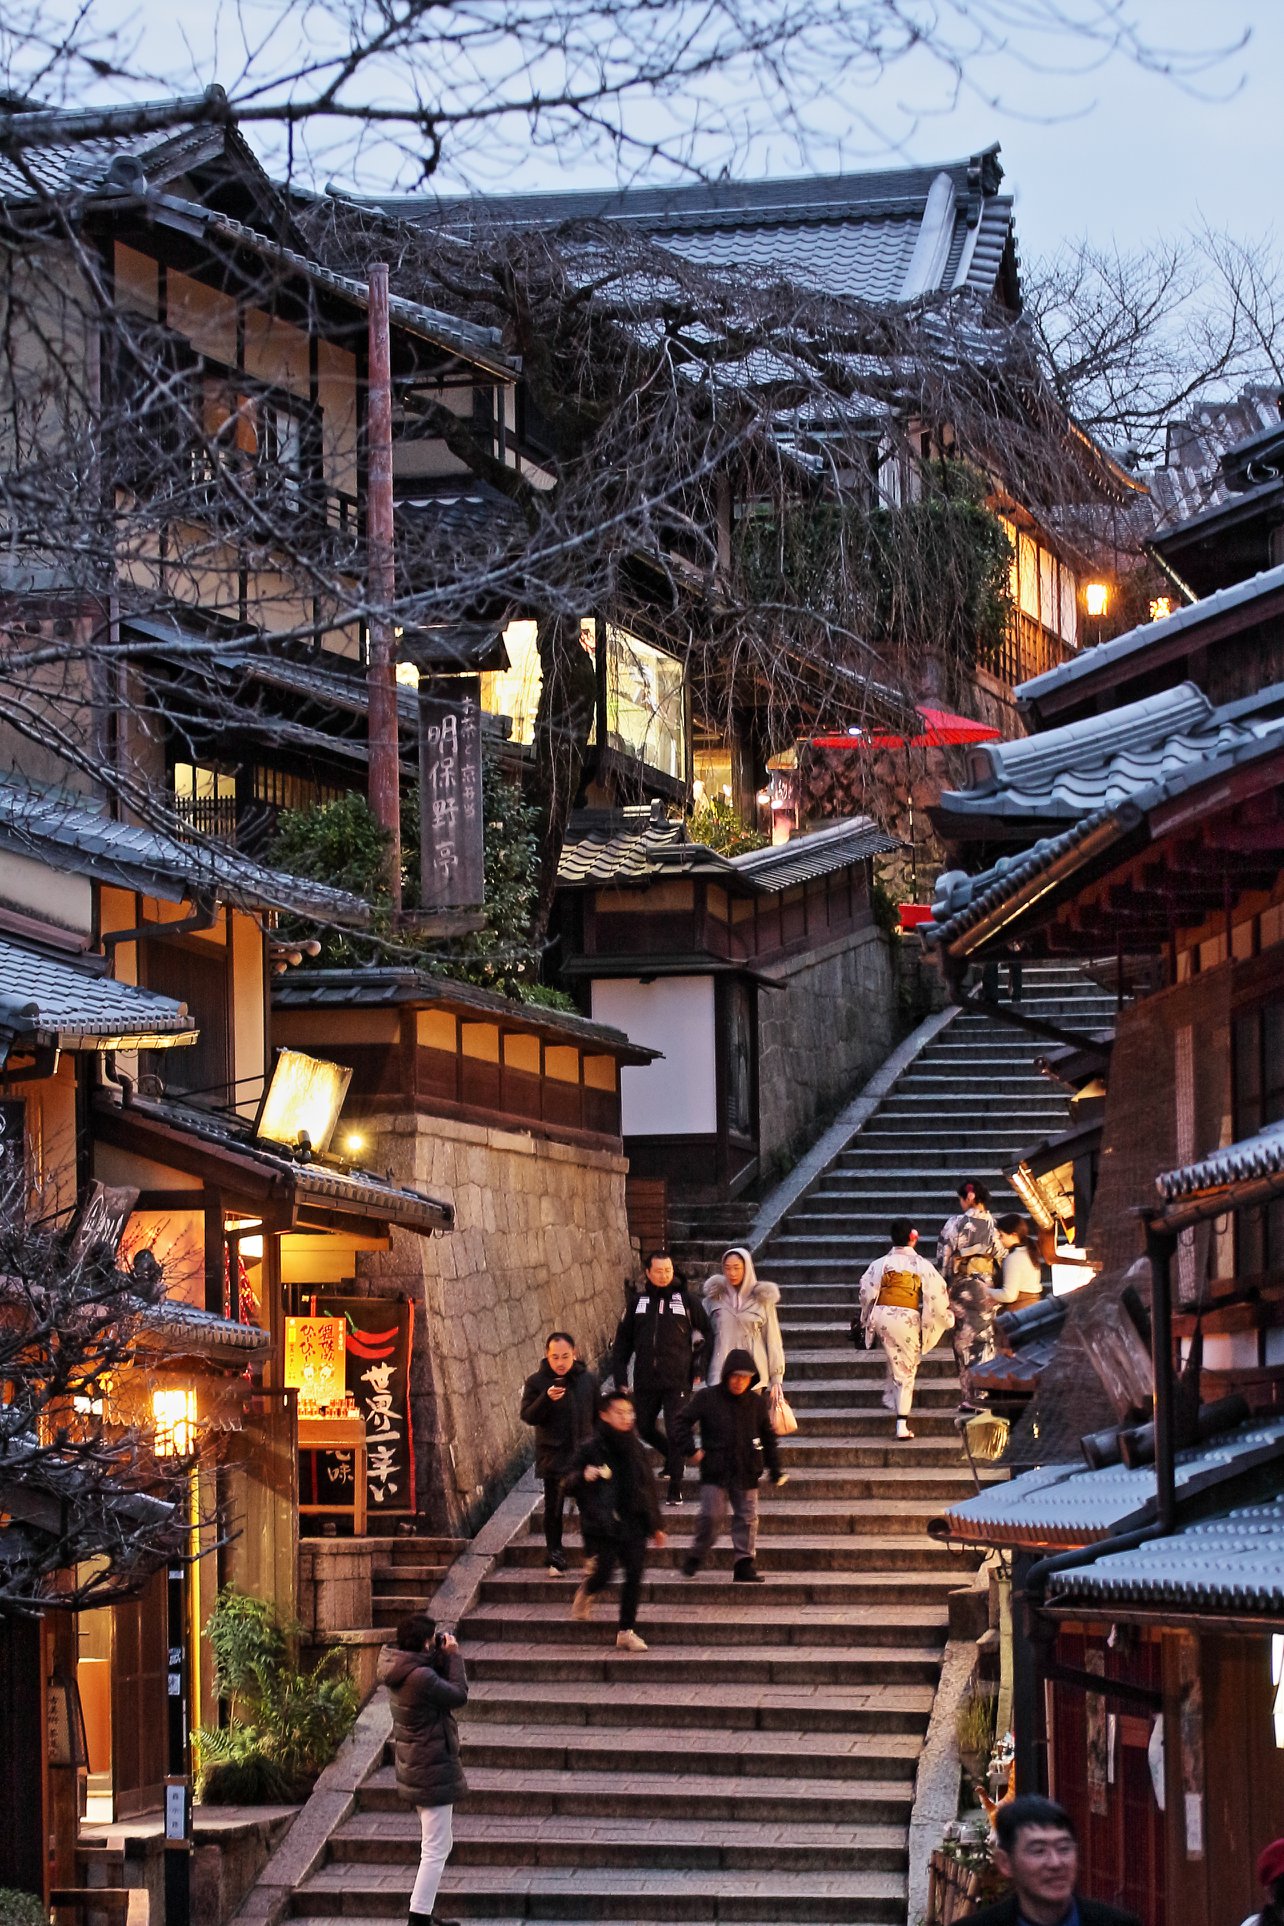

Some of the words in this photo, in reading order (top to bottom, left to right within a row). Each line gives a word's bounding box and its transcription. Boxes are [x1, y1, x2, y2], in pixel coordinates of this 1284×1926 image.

[428, 713, 459, 877] 明保野亭
[360, 1361, 403, 1503] 世界一辛い
